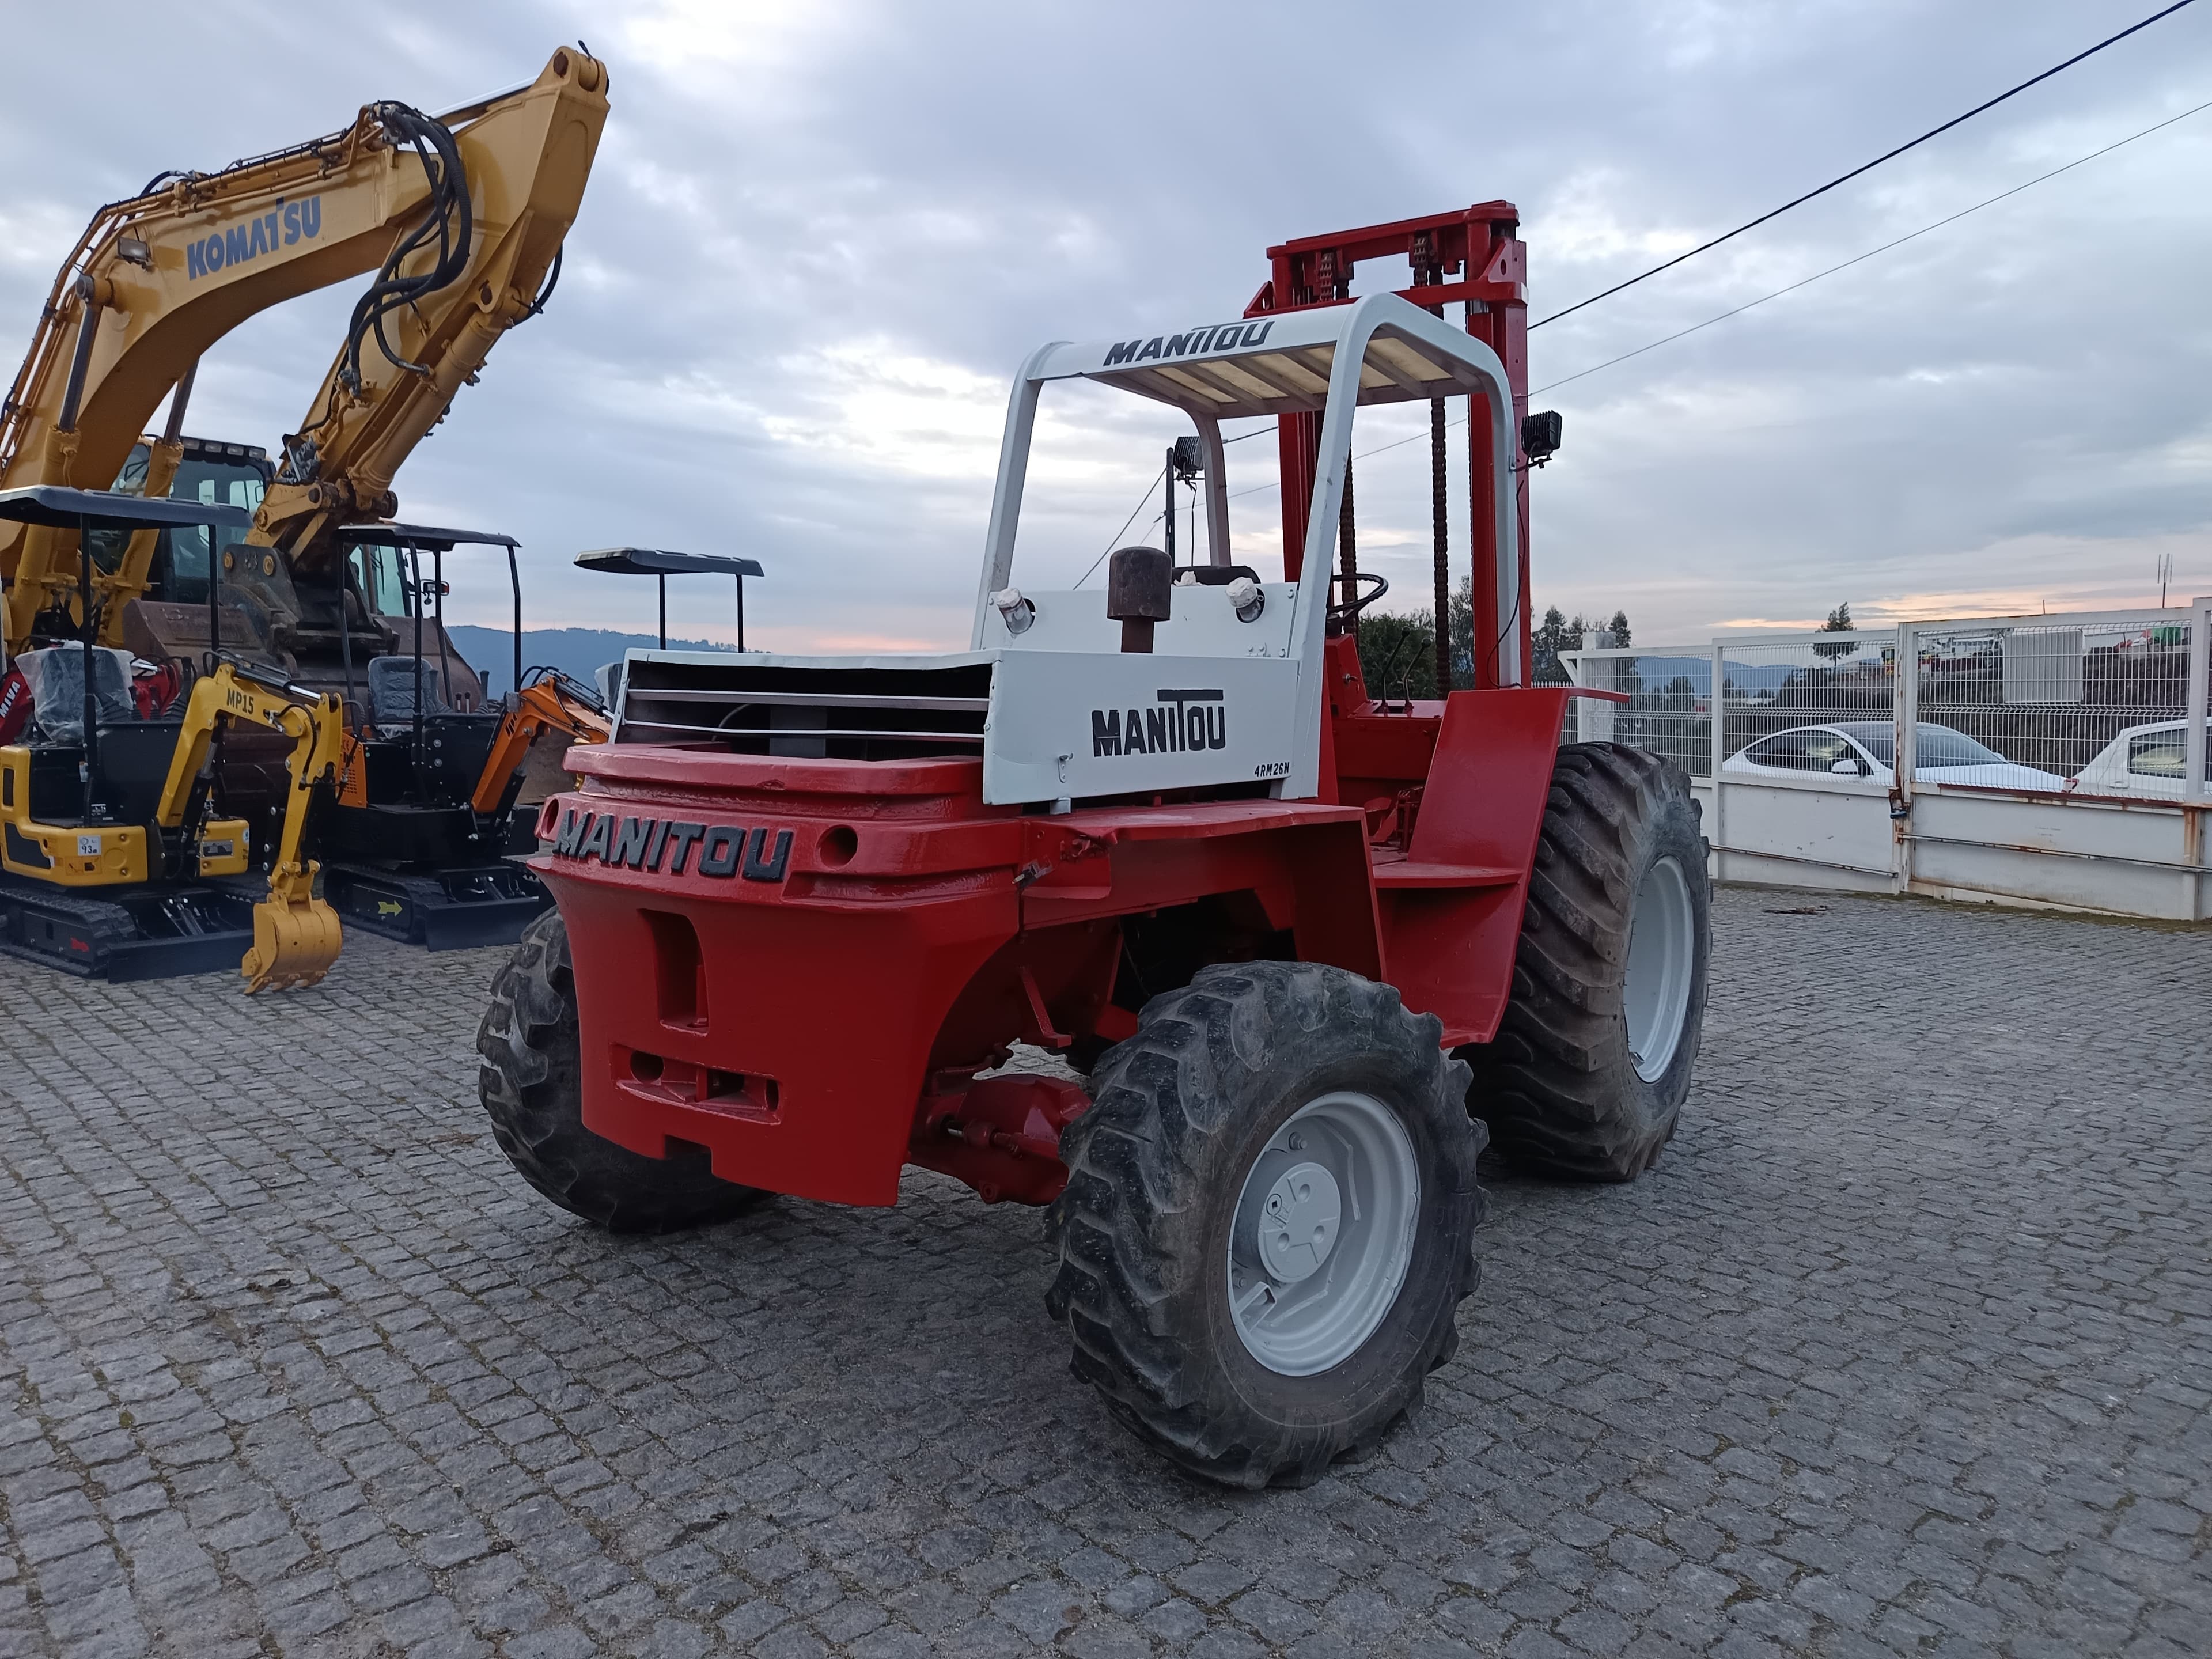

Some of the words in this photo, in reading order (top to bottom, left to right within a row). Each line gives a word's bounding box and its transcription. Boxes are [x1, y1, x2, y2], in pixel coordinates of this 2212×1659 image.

[187, 196, 321, 281] KOMATSU
[1103, 318, 1275, 366] MANITOU
[227, 688, 254, 714] MP15
[1092, 689, 1226, 757] MANITOU
[1255, 762, 1290, 777] 4RM26N
[552, 809, 794, 884] MANITOU
